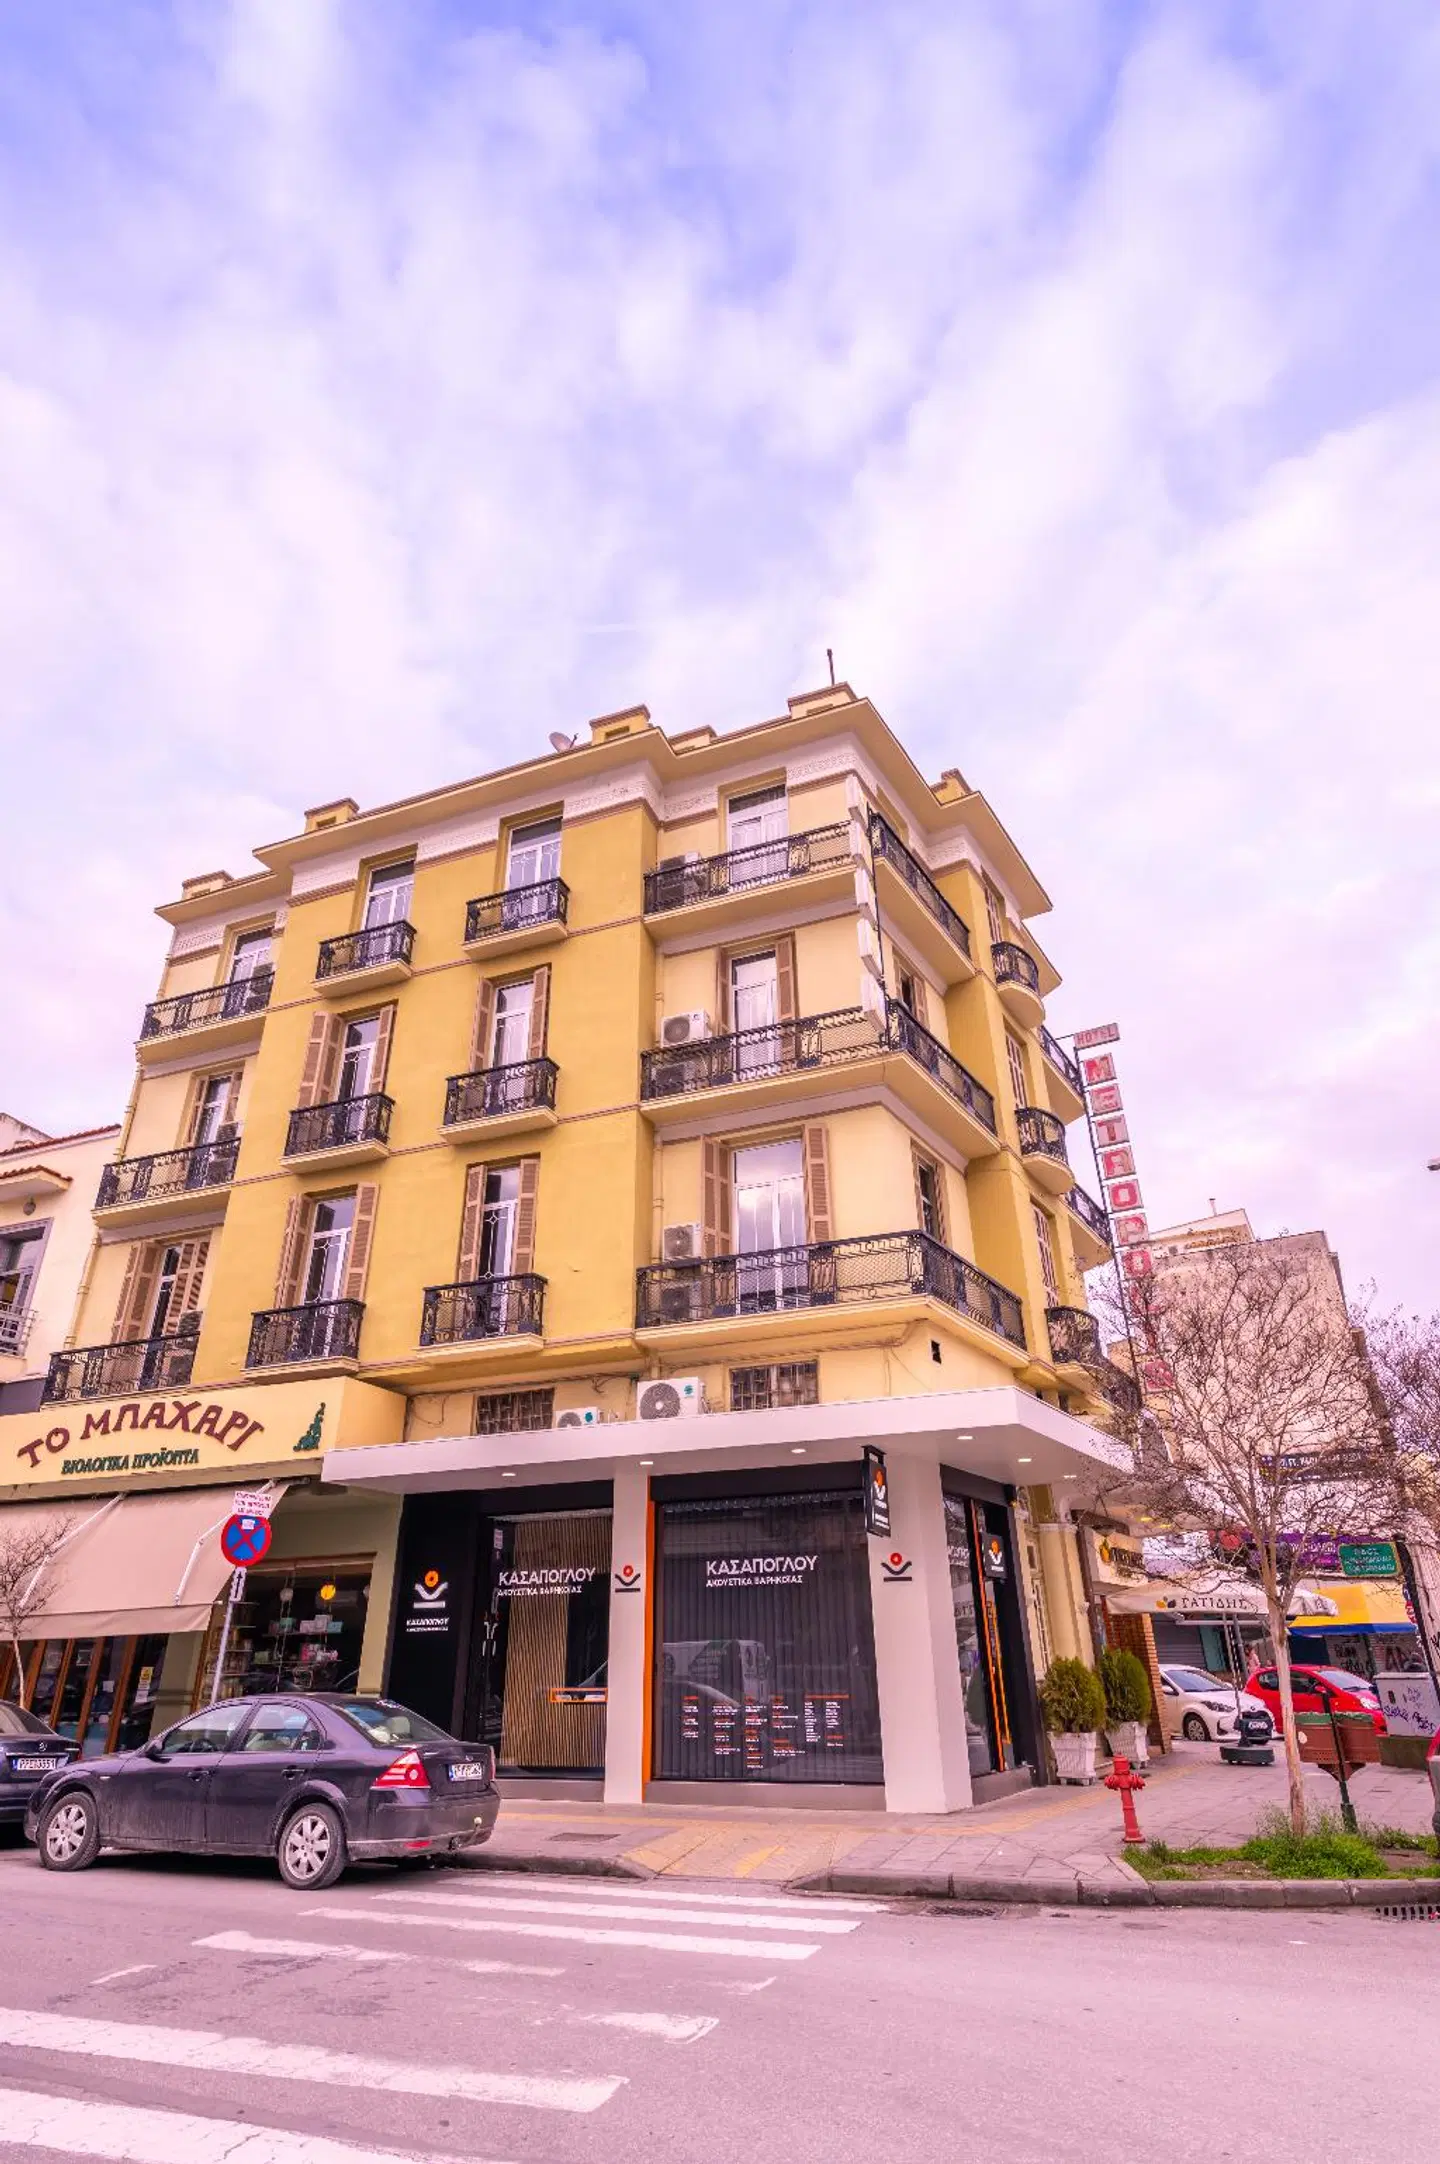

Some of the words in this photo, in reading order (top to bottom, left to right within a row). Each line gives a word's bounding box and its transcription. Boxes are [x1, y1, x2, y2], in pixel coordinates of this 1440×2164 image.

[1077, 1026, 1115, 1045] HOTEL
[17, 1427, 70, 1468] ΤΟ
[80, 1400, 265, 1451] ΜΠΑΧΑΡΙ
[61, 1455, 129, 1475] ΒΙΟΛΟΓΙΚΑ
[705, 1555, 819, 1576] ΚΑΣΑΠΟΓΛΟΥ
[499, 1567, 596, 1586] ΚΑΣΑΠΟΓΛΟΥ
[706, 1578, 752, 1588] ΑΚΟΥΣΤΙΚΑ
